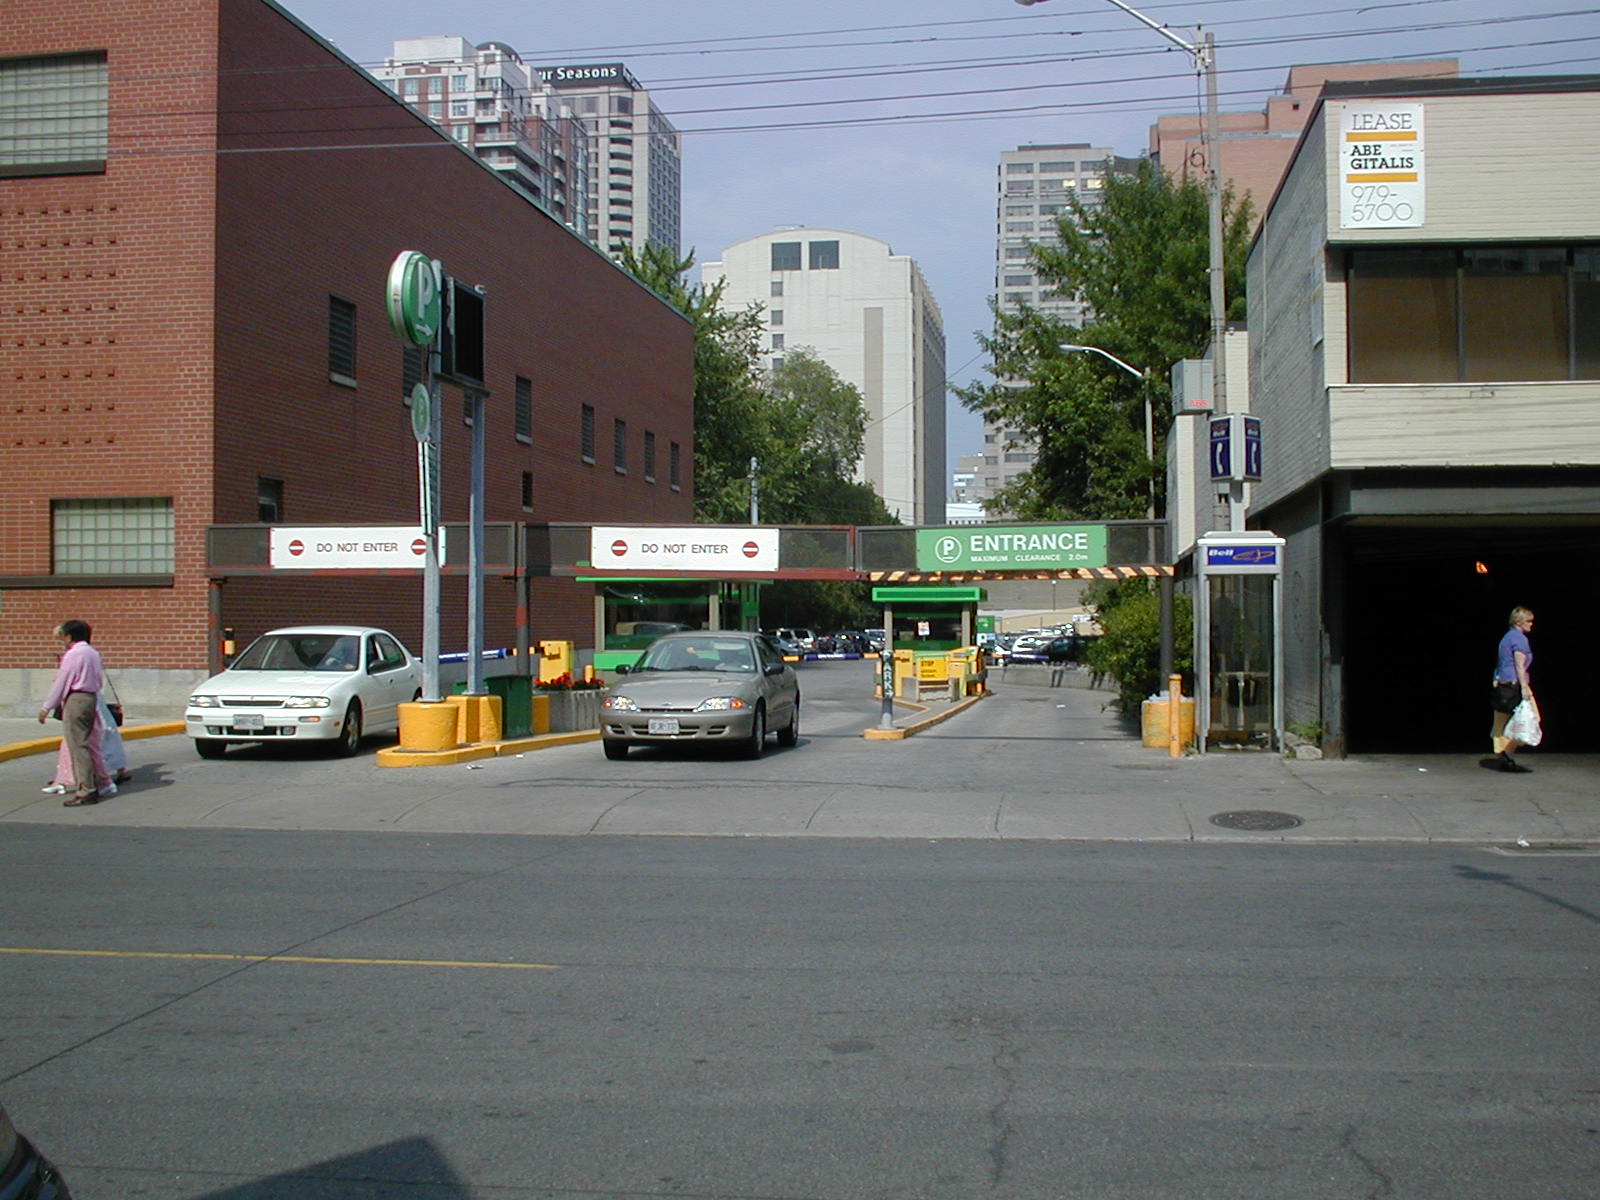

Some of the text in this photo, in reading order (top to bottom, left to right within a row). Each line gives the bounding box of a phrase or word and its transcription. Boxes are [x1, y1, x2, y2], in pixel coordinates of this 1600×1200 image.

[557, 66, 617, 80] Seasons
[1352, 113, 1412, 130] LEASE
[1350, 144, 1382, 156] ABE
[1350, 157, 1414, 169] GITALIS
[1351, 185, 1398, 203] 979-
[1352, 202, 1414, 222] 5700
[418, 261, 434, 320] P
[316, 542, 398, 553] DO NOT ENTER
[641, 543, 728, 554] DO NOT ENTER
[970, 532, 1088, 552] ENTRANCE
[970, 553, 1088, 562] MAXIMUM CLEARANCE 2.0m
[1208, 548, 1234, 557] Bell
